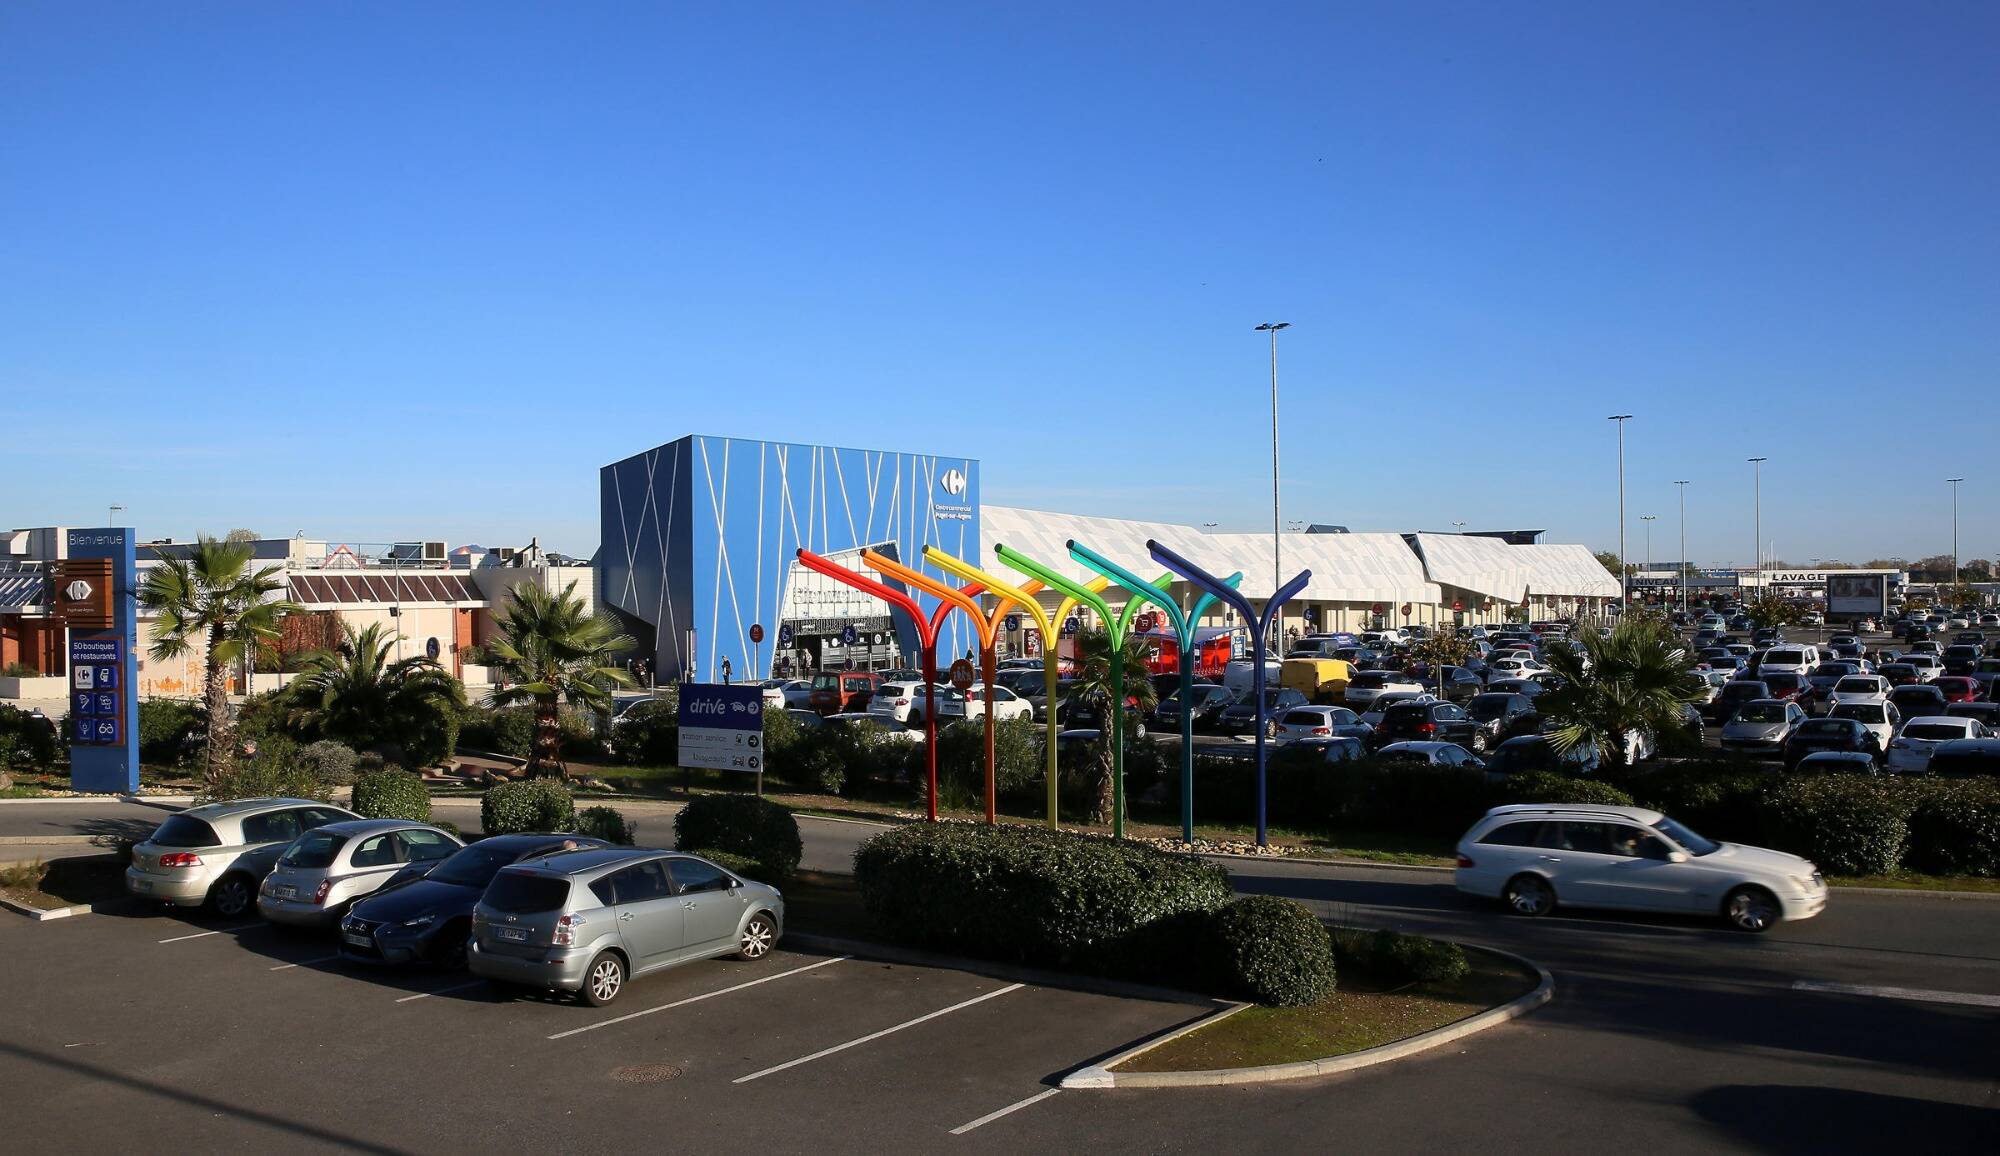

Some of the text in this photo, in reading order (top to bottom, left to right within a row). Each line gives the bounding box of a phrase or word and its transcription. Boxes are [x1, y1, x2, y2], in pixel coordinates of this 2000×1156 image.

[69, 533, 123, 545] Bienvenue
[1772, 572, 1826, 581] LAVAGE
[73, 642, 115, 651] 50 boutiques
[690, 698, 725, 714] drive
